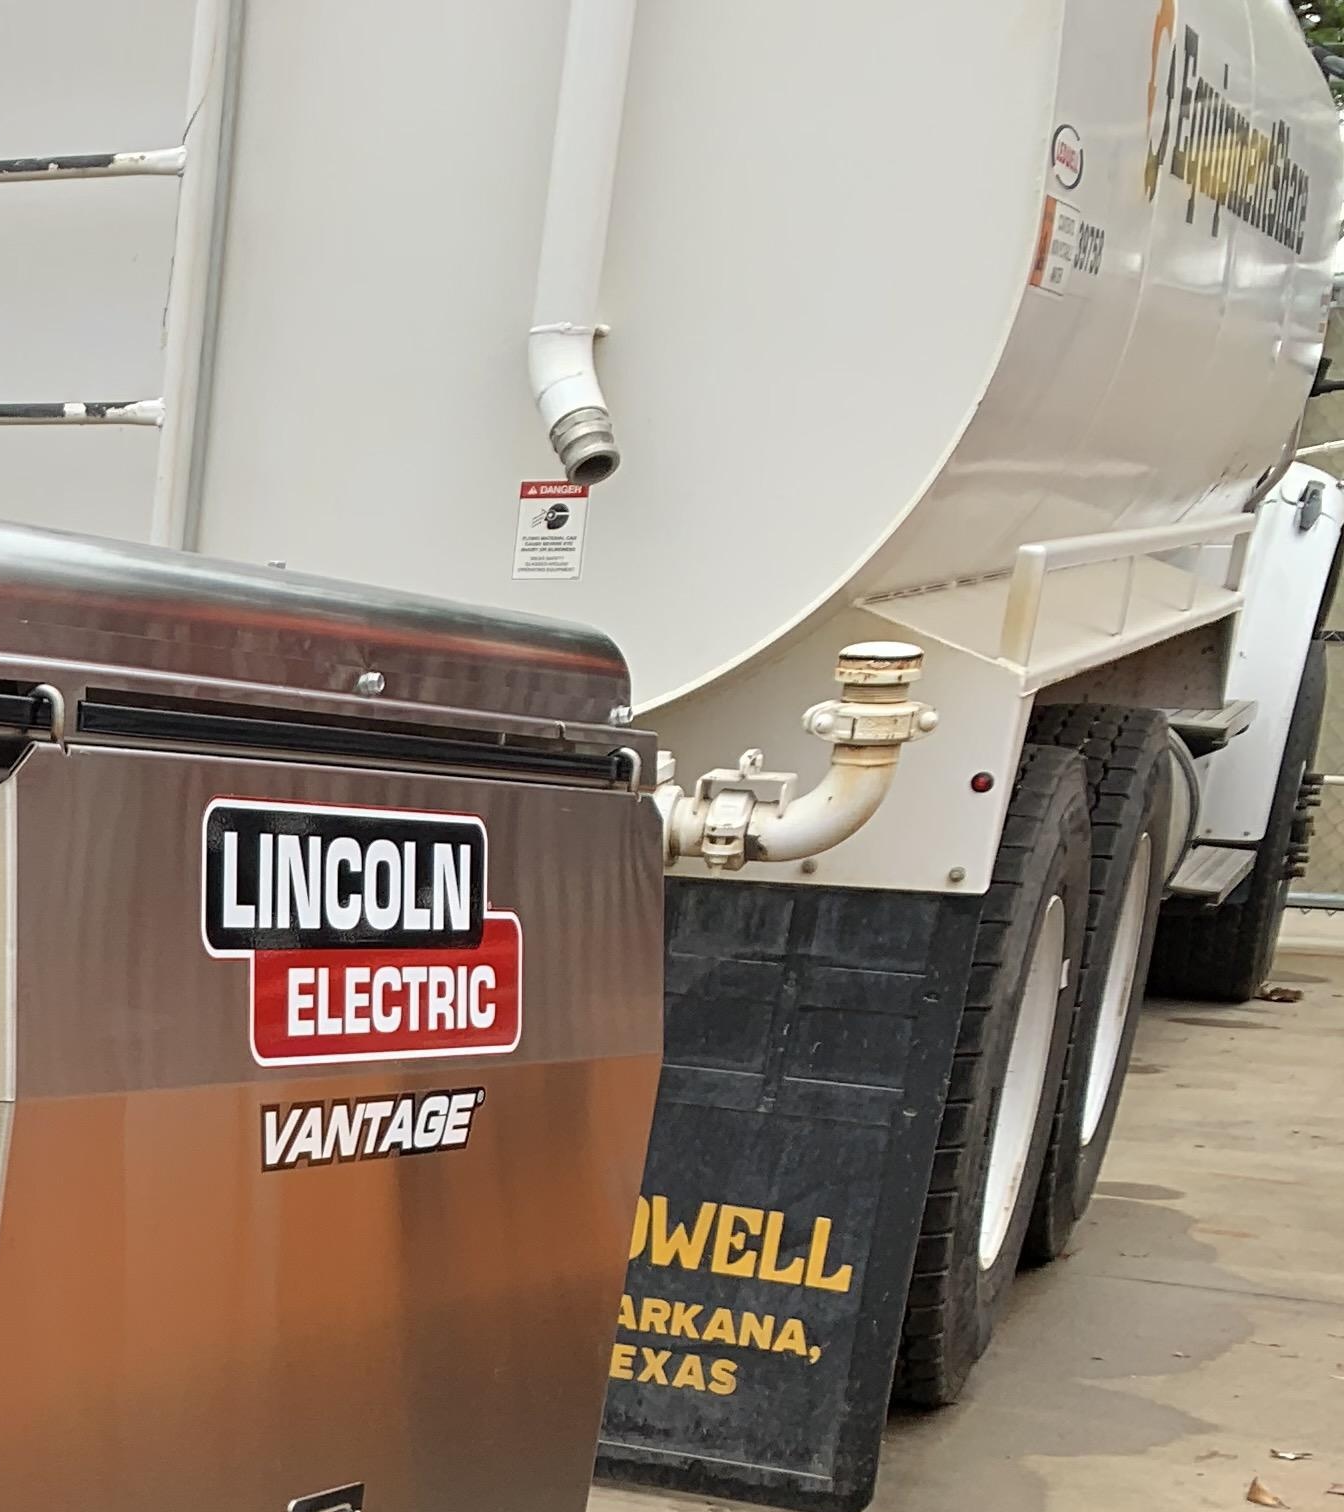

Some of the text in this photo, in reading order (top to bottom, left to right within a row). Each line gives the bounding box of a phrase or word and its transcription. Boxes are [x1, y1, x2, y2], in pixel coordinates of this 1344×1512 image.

[223, 830, 472, 931] LINCOLN
[287, 965, 497, 1037] ELECTRIC
[609, 1344, 738, 1396] EXAS
